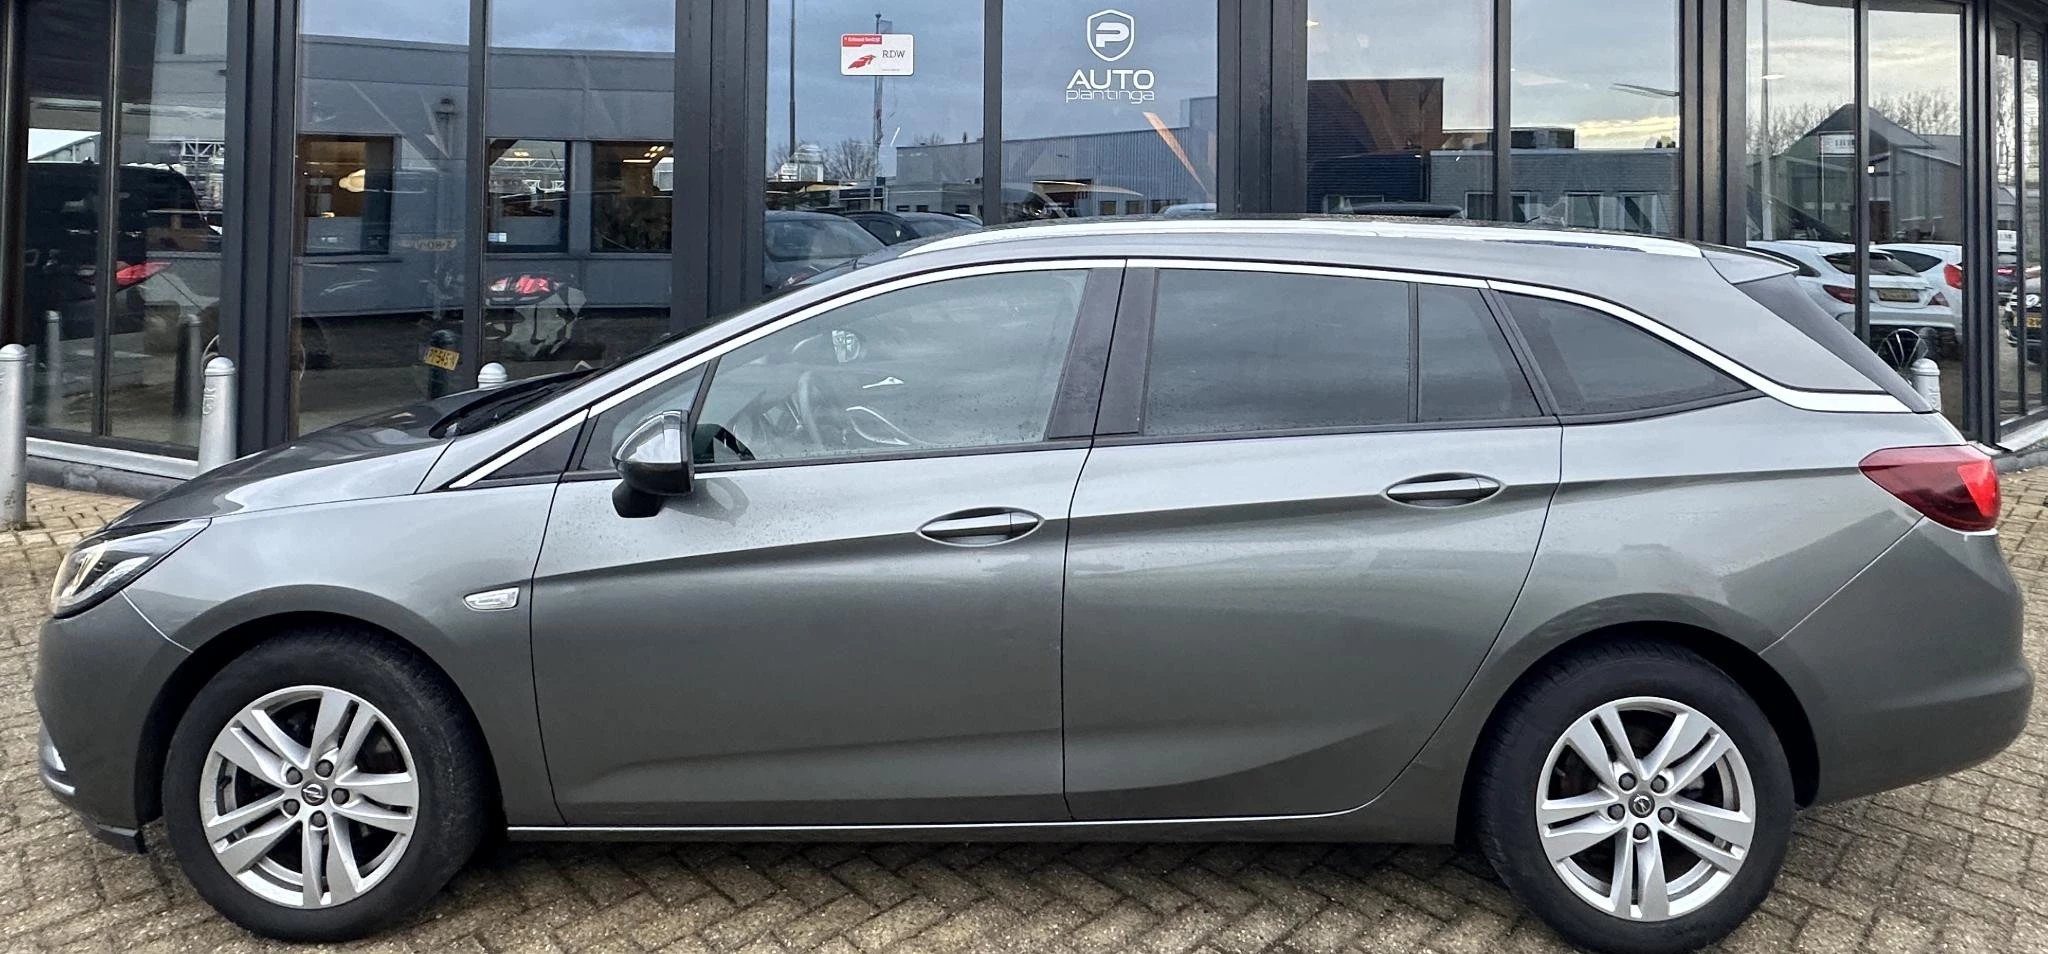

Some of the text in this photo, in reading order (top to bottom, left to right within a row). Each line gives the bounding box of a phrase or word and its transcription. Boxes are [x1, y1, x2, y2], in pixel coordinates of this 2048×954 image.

[1095, 22, 1130, 48] P
[881, 49, 906, 58] RDW
[1066, 69, 1155, 90] AUTO
[1065, 88, 1155, 105] plantinga
